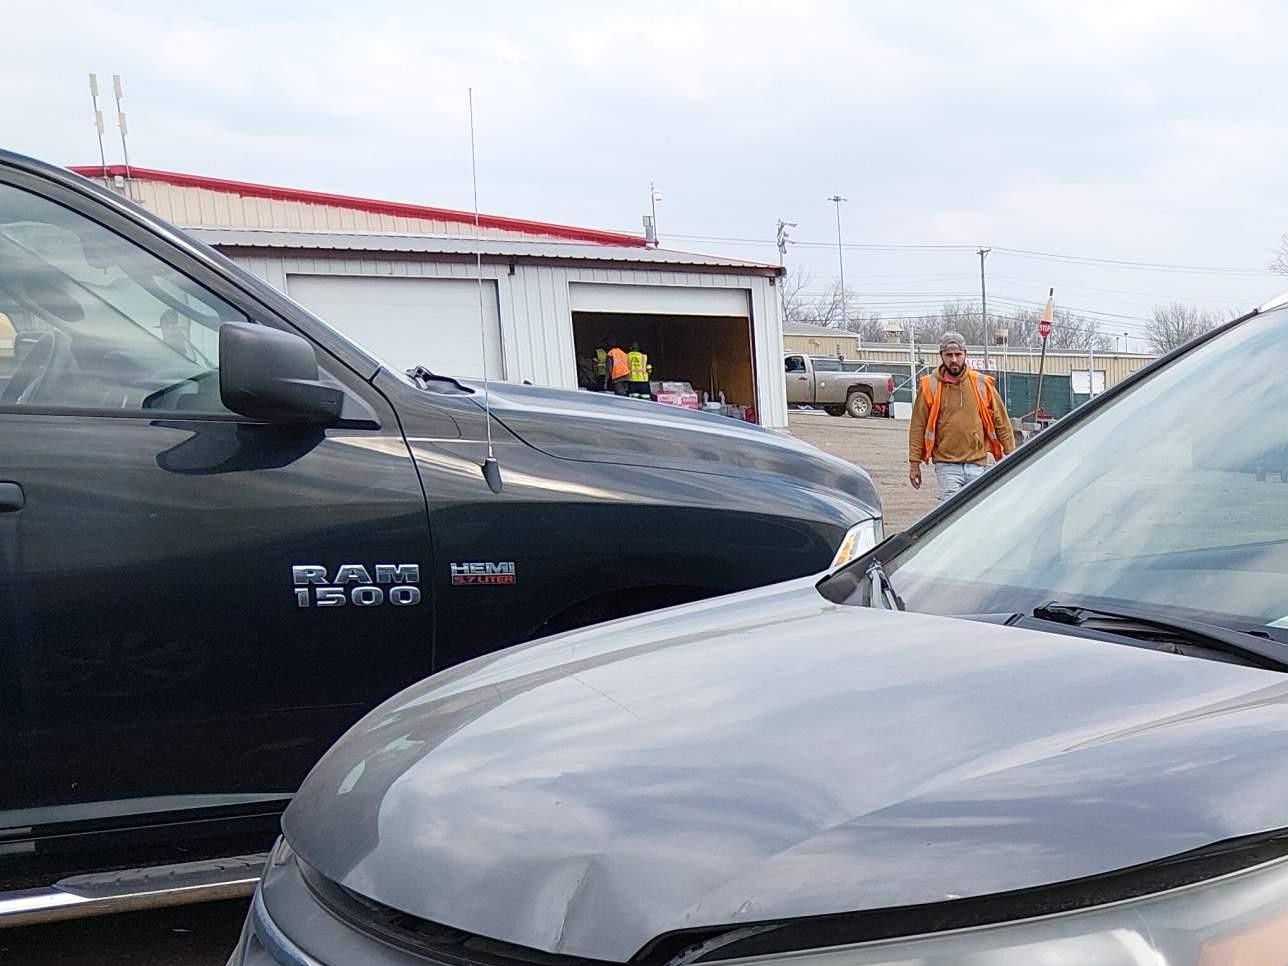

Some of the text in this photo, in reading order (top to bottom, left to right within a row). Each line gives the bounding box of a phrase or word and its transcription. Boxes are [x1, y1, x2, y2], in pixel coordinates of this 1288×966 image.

[292, 564, 420, 585] RAM
[451, 562, 515, 574] HEMI
[294, 586, 421, 607] 1500
